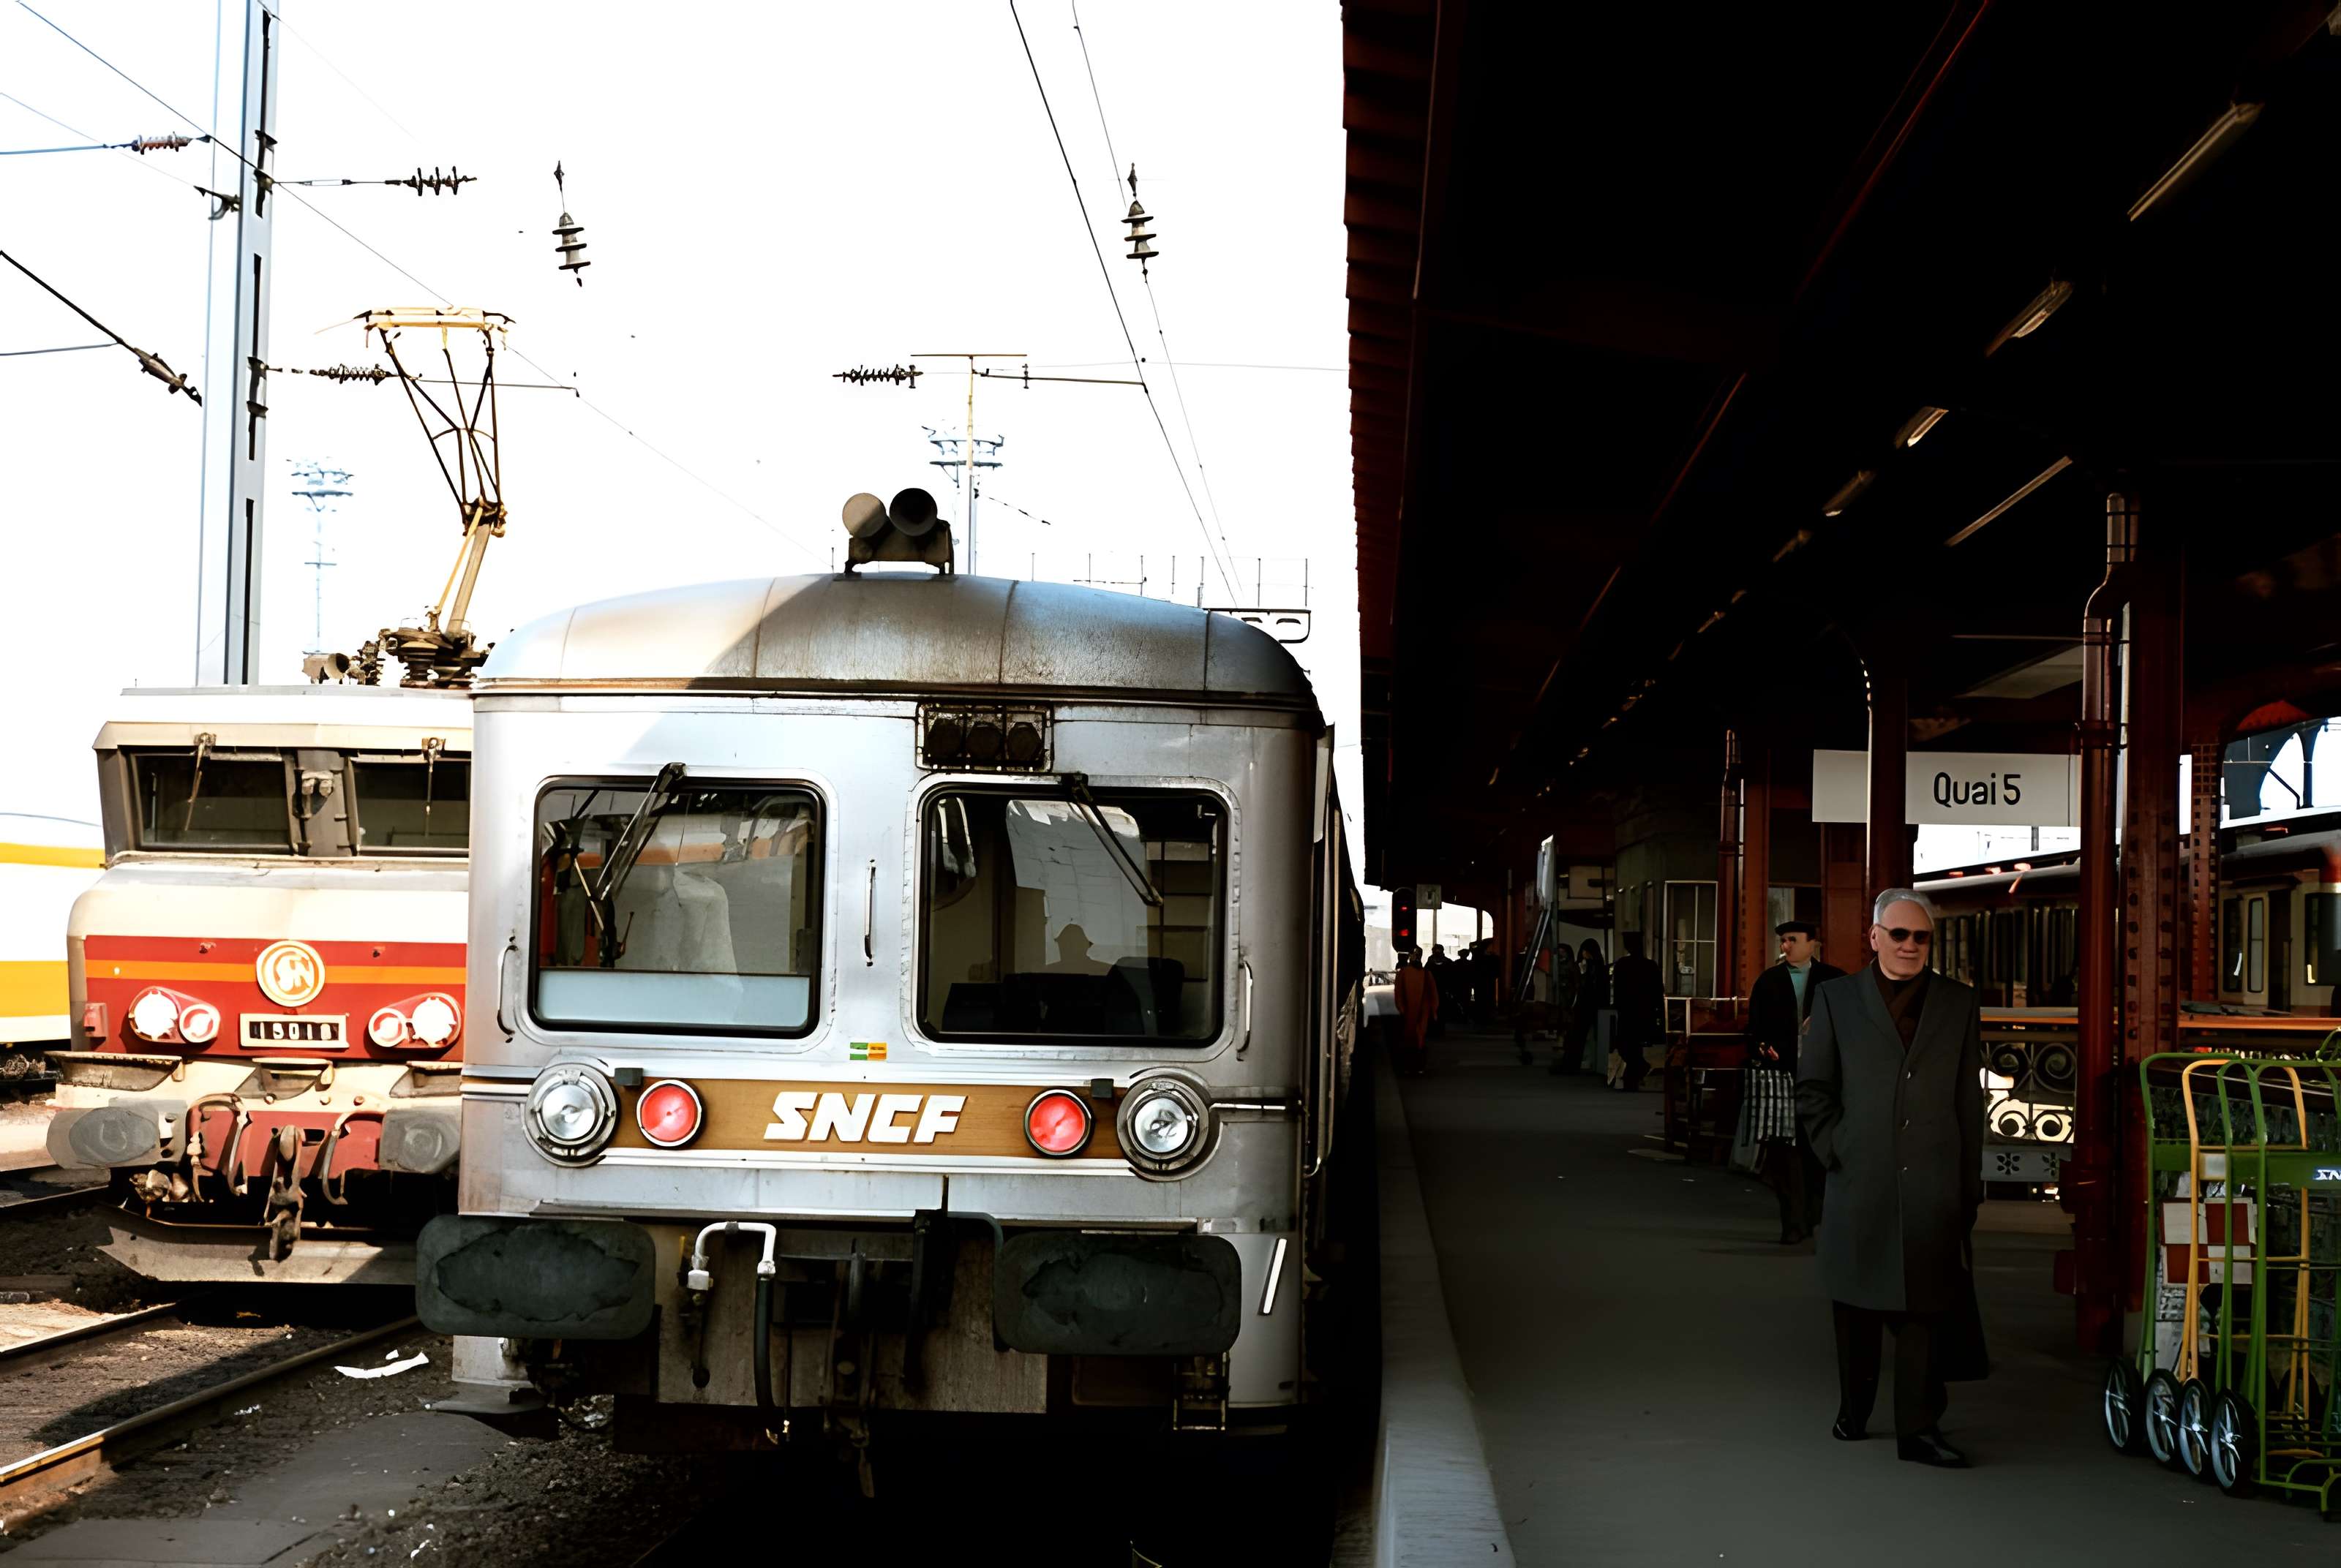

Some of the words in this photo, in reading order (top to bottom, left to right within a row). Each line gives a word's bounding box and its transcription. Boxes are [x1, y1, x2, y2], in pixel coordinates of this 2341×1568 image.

[1934, 772, 1996, 808] Quai
[2003, 773, 2021, 806] 5
[763, 1090, 967, 1144] SNCF
